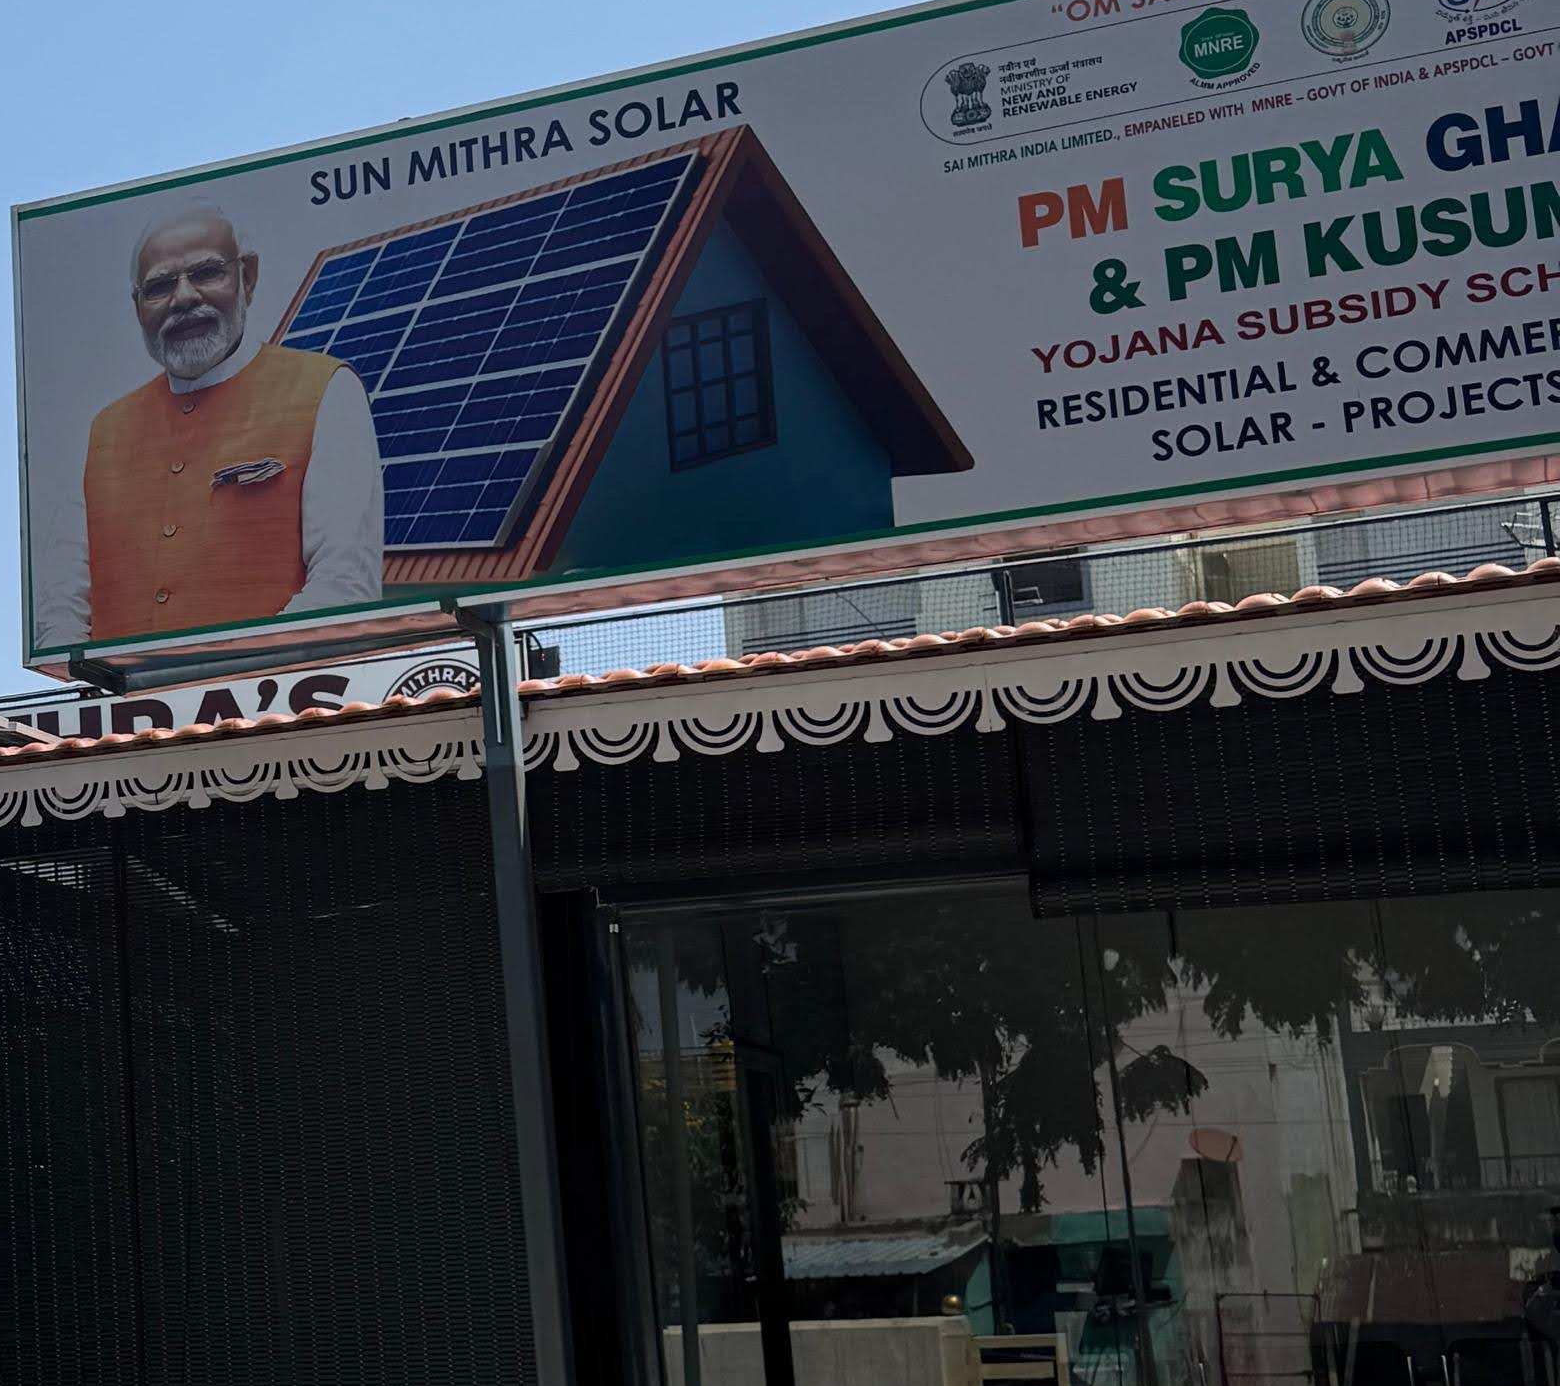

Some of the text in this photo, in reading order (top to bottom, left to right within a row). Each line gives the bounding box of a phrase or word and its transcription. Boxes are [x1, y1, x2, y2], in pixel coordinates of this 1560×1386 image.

[1193, 34, 1244, 57] MNRE
[1444, 18, 1522, 45] APSPDCL
[943, 41, 1554, 173] SAI MITHRA INDIA EMPANELED WITH MNRE GOVT OF INDIA & APSPDCL GOVT
[1000, 72, 1070, 98] MINISTRY OF
[1001, 82, 1066, 107] NEW AND
[1002, 81, 1137, 117] RENEWABLE ENERGY
[310, 81, 740, 205] SUN MITHRA SOLAR
[1018, 177, 1128, 247] PM
[1153, 129, 1401, 221] SURYA
[1088, 258, 1145, 314] &
[1164, 230, 1279, 300] PM
[1031, 319, 1224, 373] YOJANA
[1237, 279, 1448, 340] SUBSIDY
[1037, 361, 1296, 429] RESIDENTIAL
[1311, 355, 1341, 387] &
[1151, 369, 1560, 461] SOLAR PROJECTS
